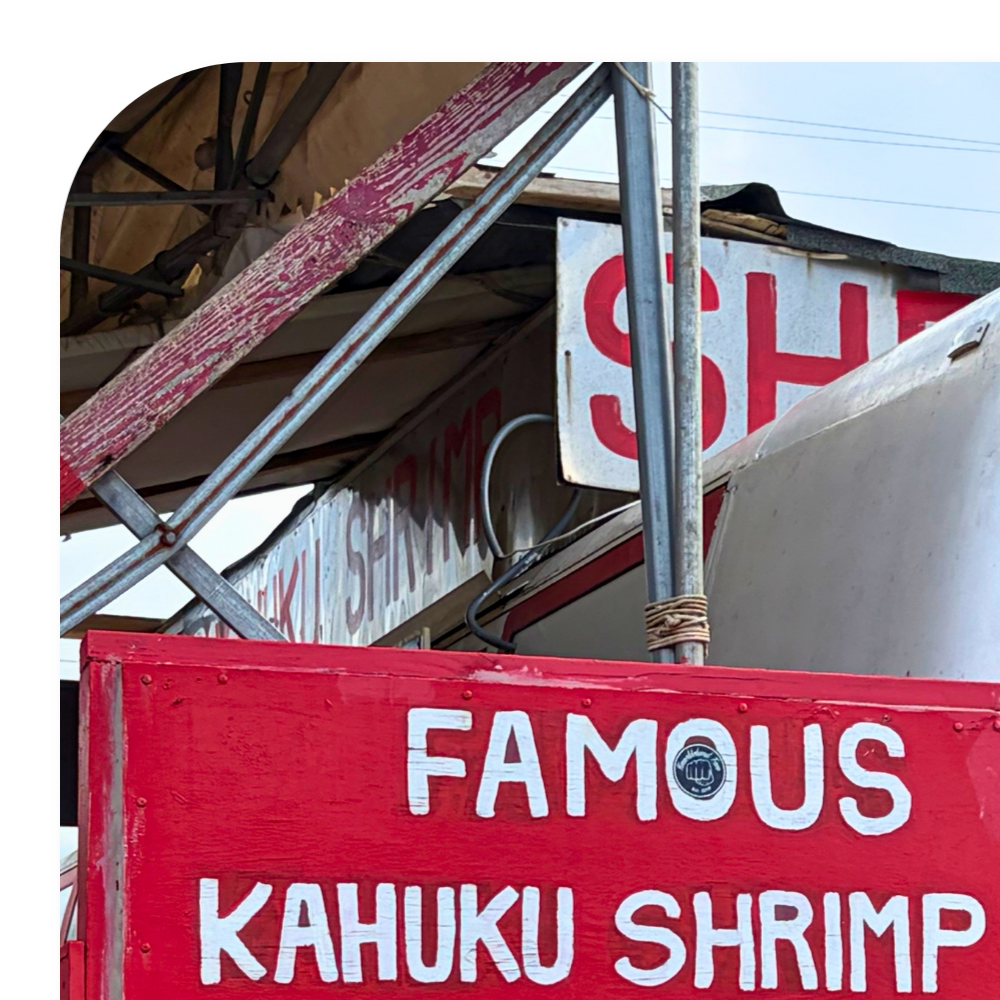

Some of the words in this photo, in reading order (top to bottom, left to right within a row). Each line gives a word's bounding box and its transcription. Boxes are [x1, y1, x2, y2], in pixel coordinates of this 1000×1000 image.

[407, 708, 912, 836] FAMOUS
[199, 878, 574, 986] KAHUKU
[615, 890, 986, 994] SHRIMP
